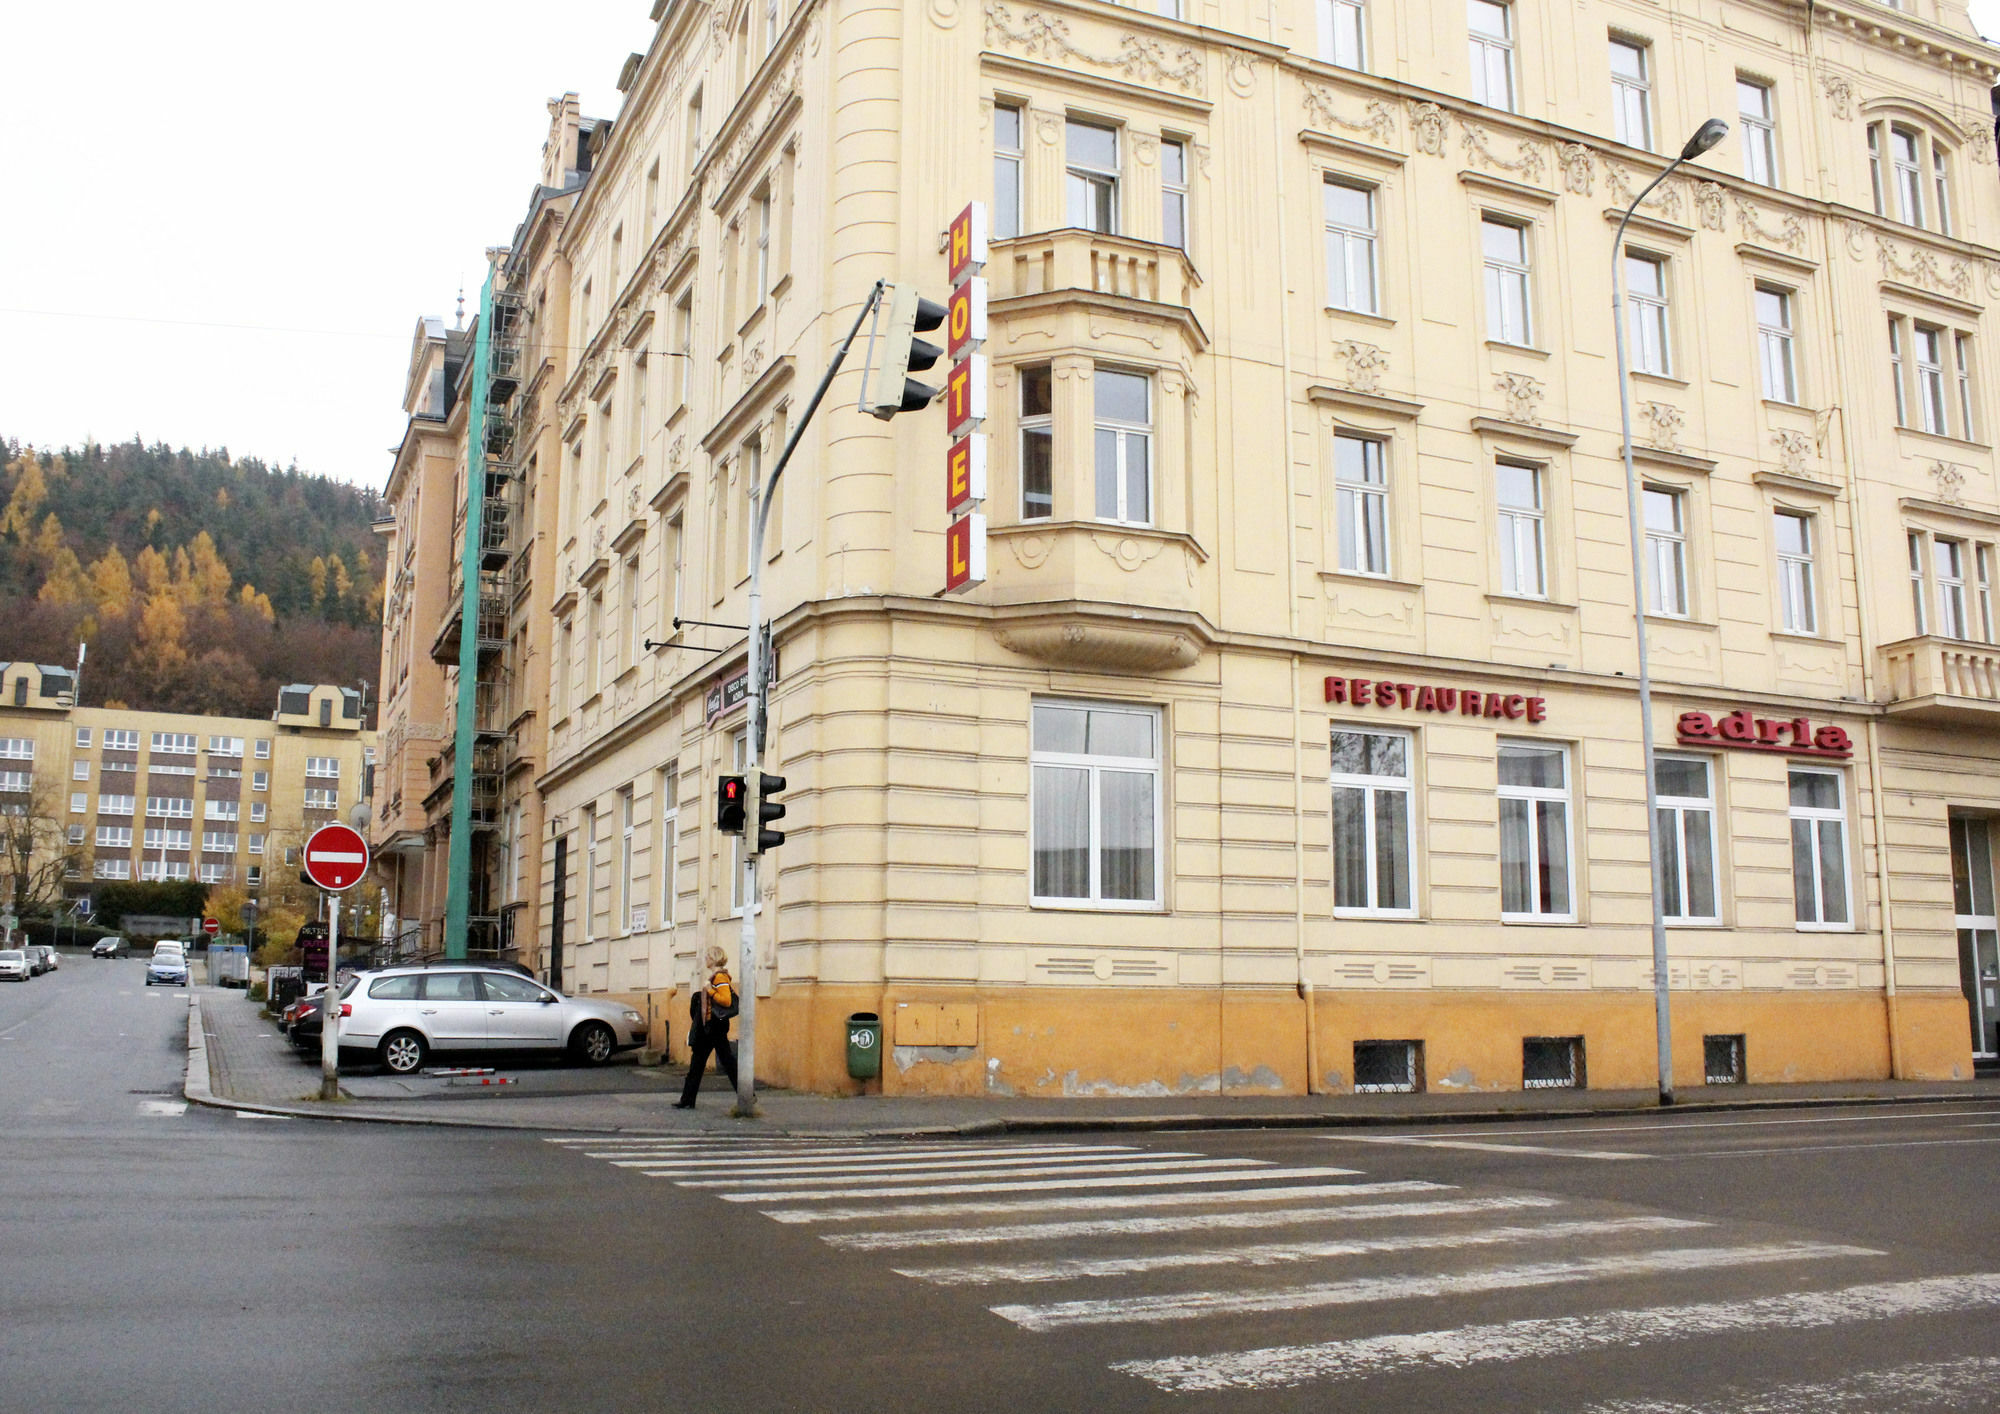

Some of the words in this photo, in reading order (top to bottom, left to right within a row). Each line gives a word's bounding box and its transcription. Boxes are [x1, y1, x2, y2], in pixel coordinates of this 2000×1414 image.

[951, 218, 969, 577] HOTEL
[1324, 676, 1546, 723] RESTAURACE
[1677, 710, 1853, 751] adria
